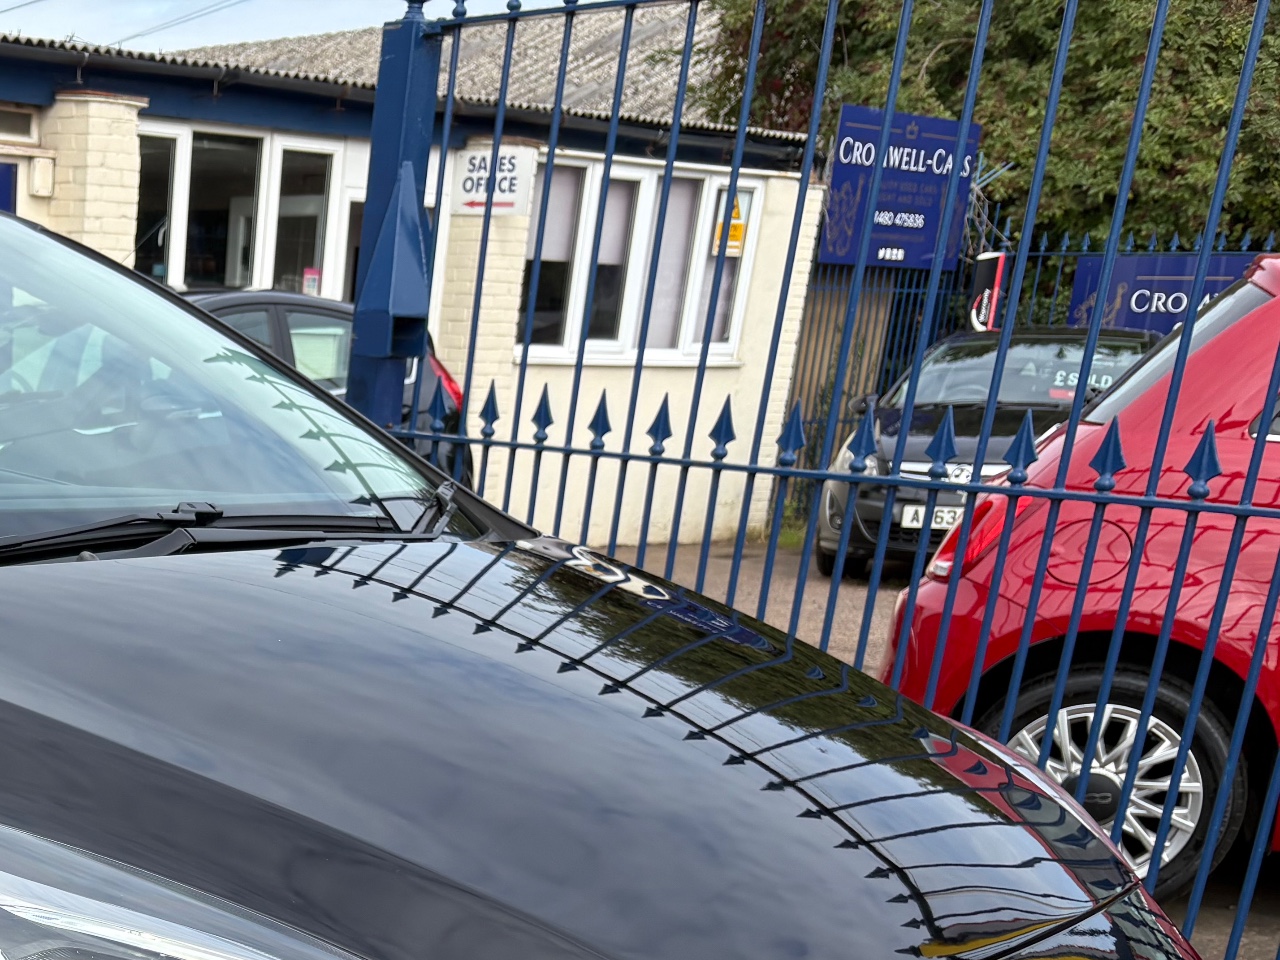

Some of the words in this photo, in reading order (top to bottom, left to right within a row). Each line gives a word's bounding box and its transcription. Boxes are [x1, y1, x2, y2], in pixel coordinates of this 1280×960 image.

[467, 155, 517, 173] SAES
[839, 136, 972, 178] CROWELL-CAS
[463, 176, 517, 193] OFCE
[1053, 370, 1113, 389] £SLD
[910, 508, 958, 525] A63
